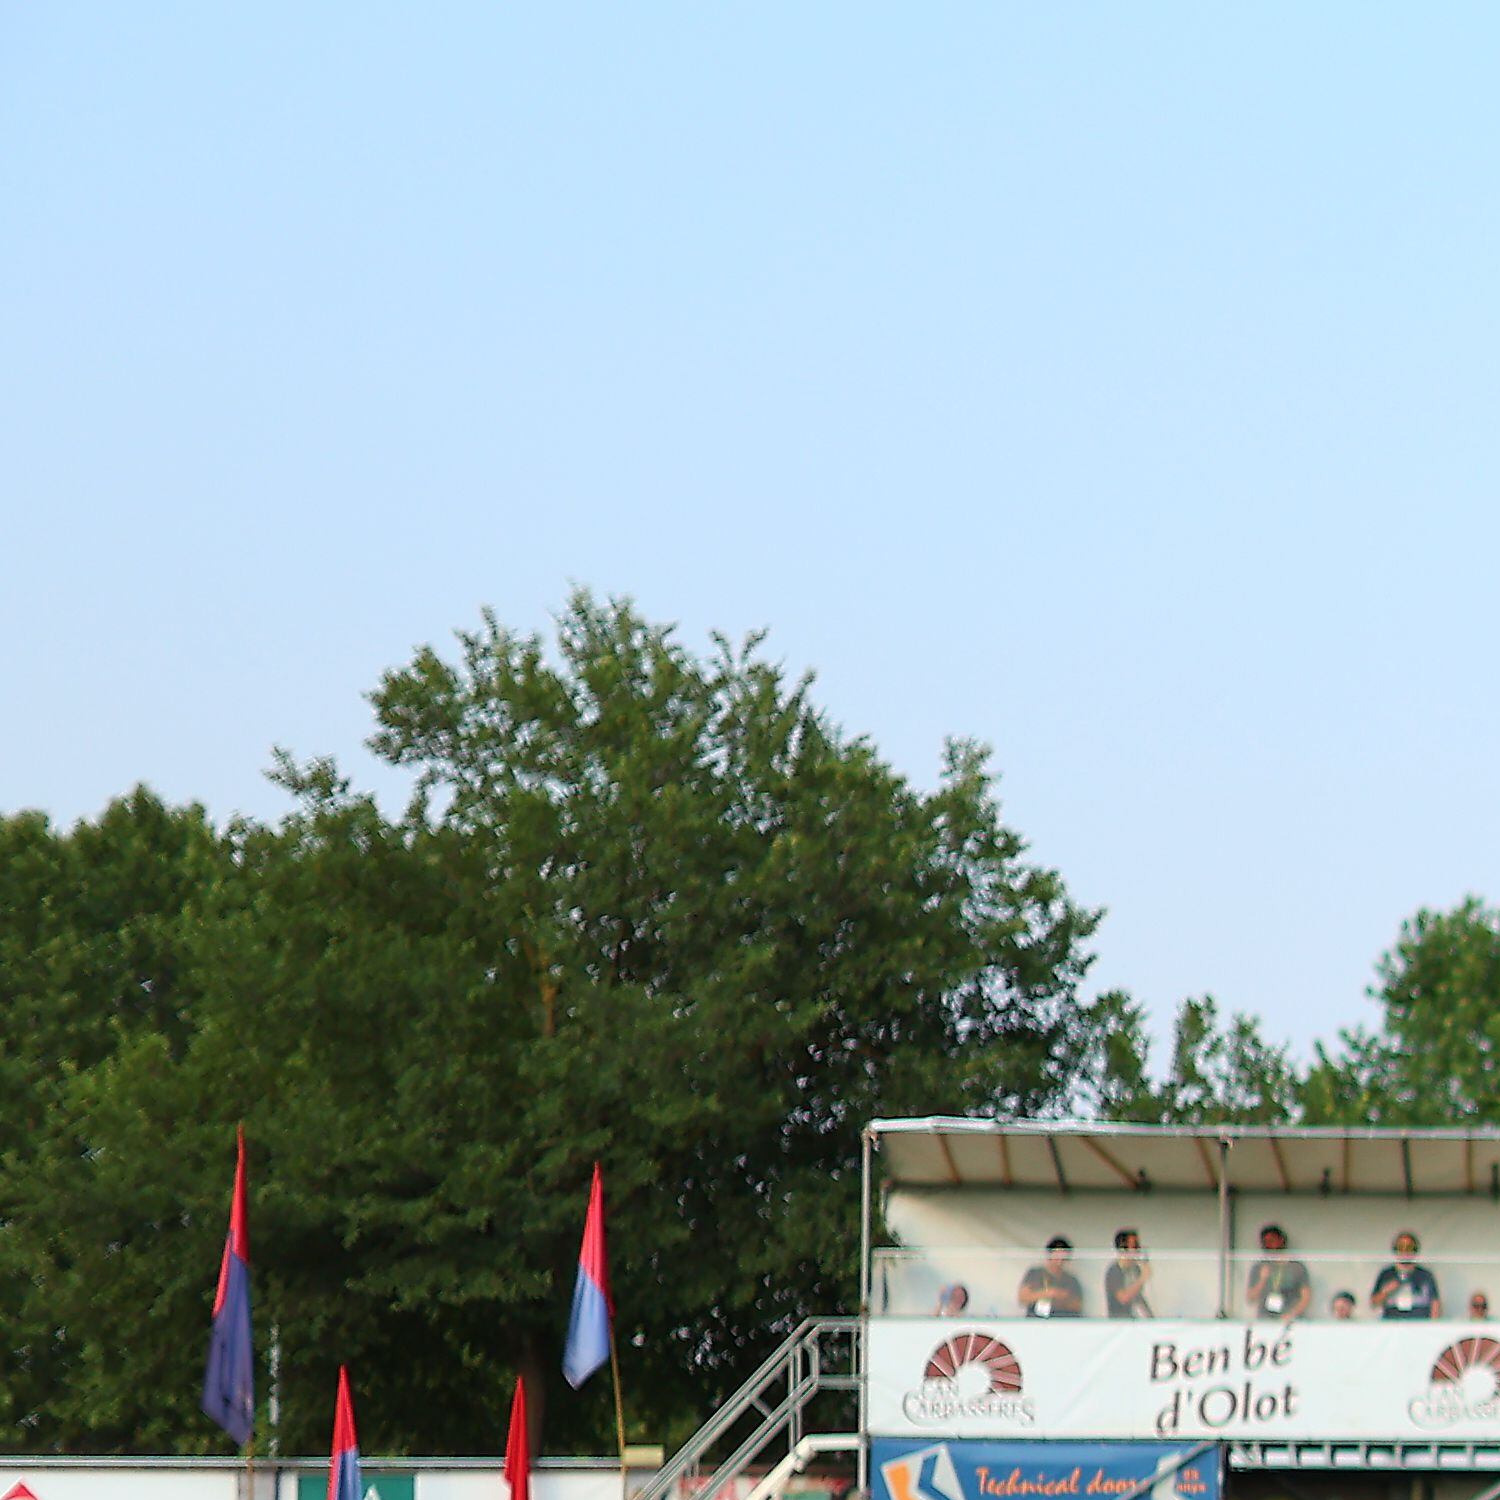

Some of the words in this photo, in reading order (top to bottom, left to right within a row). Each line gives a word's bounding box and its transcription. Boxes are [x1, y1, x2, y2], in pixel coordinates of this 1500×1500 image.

[1150, 1344, 1230, 1382] Ben
[1156, 1382, 1298, 1434] d'Olot
[976, 1466, 1082, 1496] Technical
